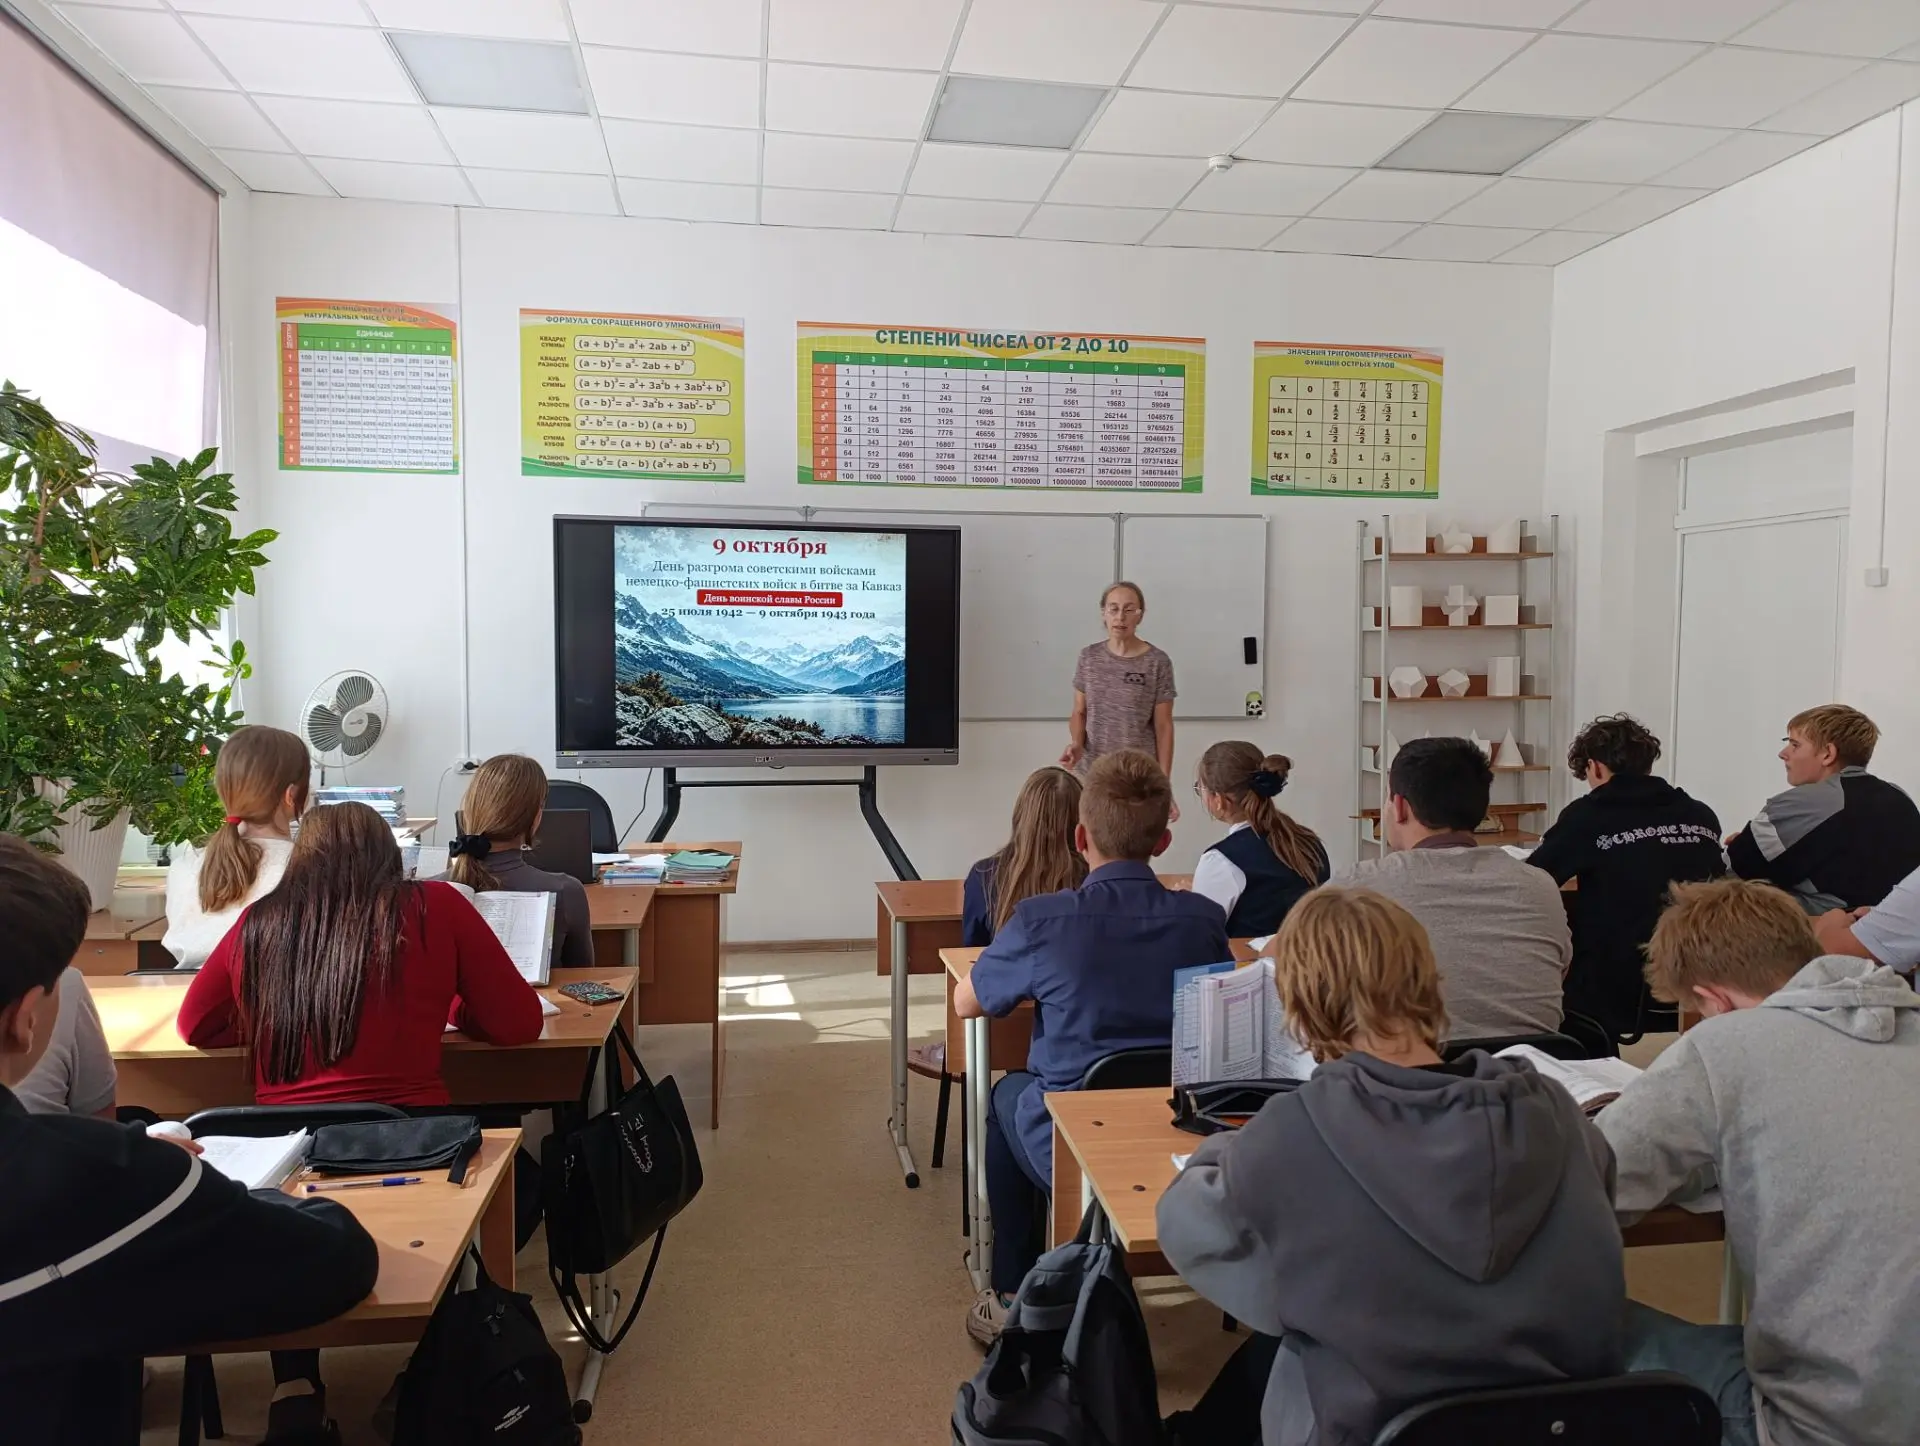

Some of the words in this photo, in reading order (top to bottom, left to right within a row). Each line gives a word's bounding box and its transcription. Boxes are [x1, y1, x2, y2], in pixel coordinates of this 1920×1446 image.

[545, 316, 589, 325] ФОРМУЛА
[591, 318, 663, 328] СОКРАЩЕННОГО
[665, 320, 721, 330] УМНОЖЕНИЯ
[875, 329, 961, 347] СТЕПЕНИ
[966, 332, 1028, 349] ЧИСЕЛ
[1033, 337, 1056, 350] ОТ
[1061, 338, 1071, 351] 2
[1075, 338, 1102, 355] ДО
[1108, 339, 1129, 353] 10
[1341, 360, 1372, 368] ОСТРЫХ
[1307, 385, 1313, 393] 0
[939, 394, 952, 402] 243
[1272, 406, 1286, 414] sin
[843, 426, 853, 434] 36
[1411, 433, 1417, 441] 0
[843, 449, 853, 457] 64
[867, 450, 880, 458] 512
[1273, 451, 1282, 460] tg
[1305, 452, 1311, 460] 0
[865, 473, 882, 481] 1000
[895, 474, 916, 482] 10000
[1270, 475, 1284, 483] ctg
[712, 538, 726, 556] 9
[732, 537, 828, 559] октября
[652, 560, 684, 573] День
[687, 563, 744, 575] разгрома
[746, 565, 816, 575] советскими
[820, 565, 876, 576] войсками
[625, 577, 760, 589] немецко-фашистских
[762, 579, 797, 590] войск
[800, 582, 807, 590] в
[809, 580, 843, 590] битве
[845, 583, 858, 591] за
[861, 581, 902, 592] Кавказ
[704, 593, 728, 603] День
[729, 594, 773, 604] воинской
[774, 596, 802, 604] славы
[804, 595, 836, 604] России
[661, 608, 675, 617] 25
[678, 608, 712, 616] июля
[716, 609, 743, 618] 1942
[759, 609, 766, 618] 9
[769, 609, 818, 619] октября
[821, 611, 847, 620] 1943
[850, 611, 876, 619] года
[1611, 825, 1679, 844] CHROME
